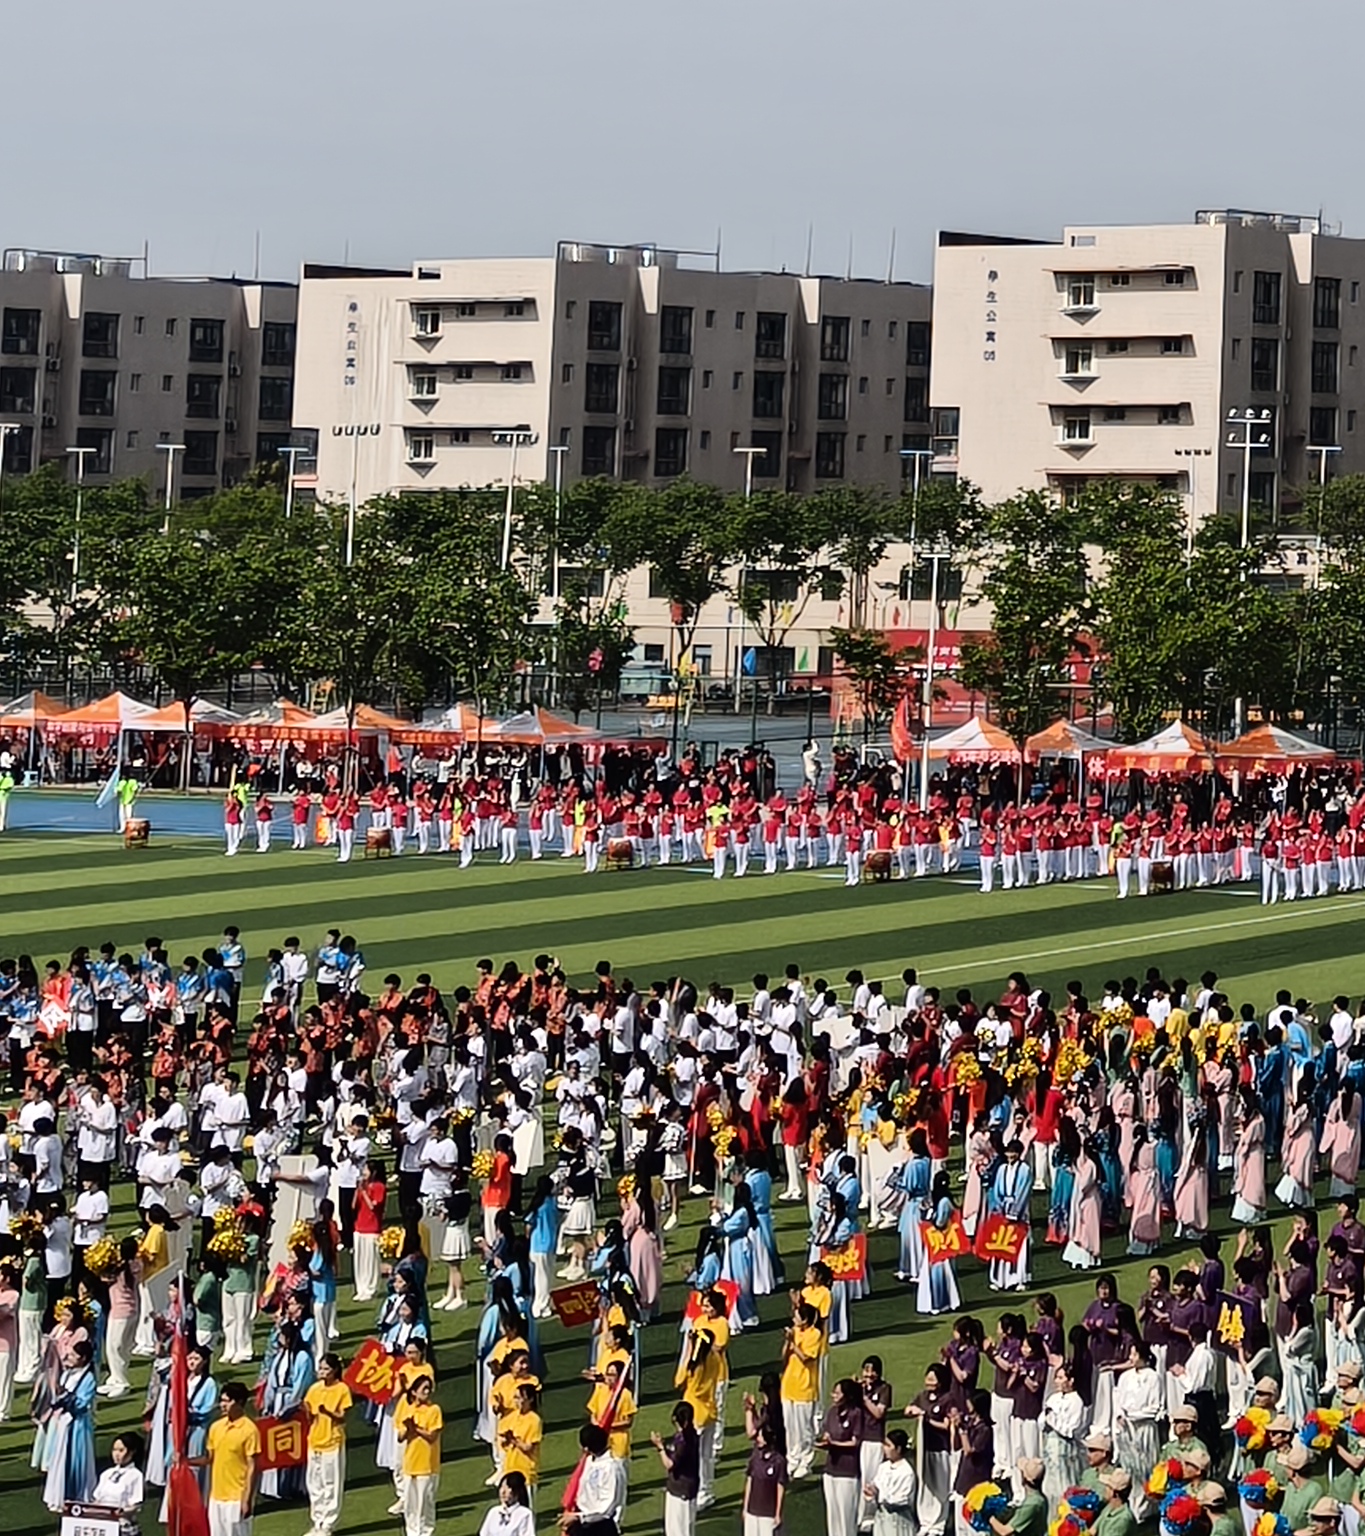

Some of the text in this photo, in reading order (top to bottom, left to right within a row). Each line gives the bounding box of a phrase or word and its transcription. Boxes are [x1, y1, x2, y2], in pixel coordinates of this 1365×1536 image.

[985, 1224, 1017, 1255] 业
[354, 1348, 395, 1393] 协
[267, 1420, 302, 1462] 同
